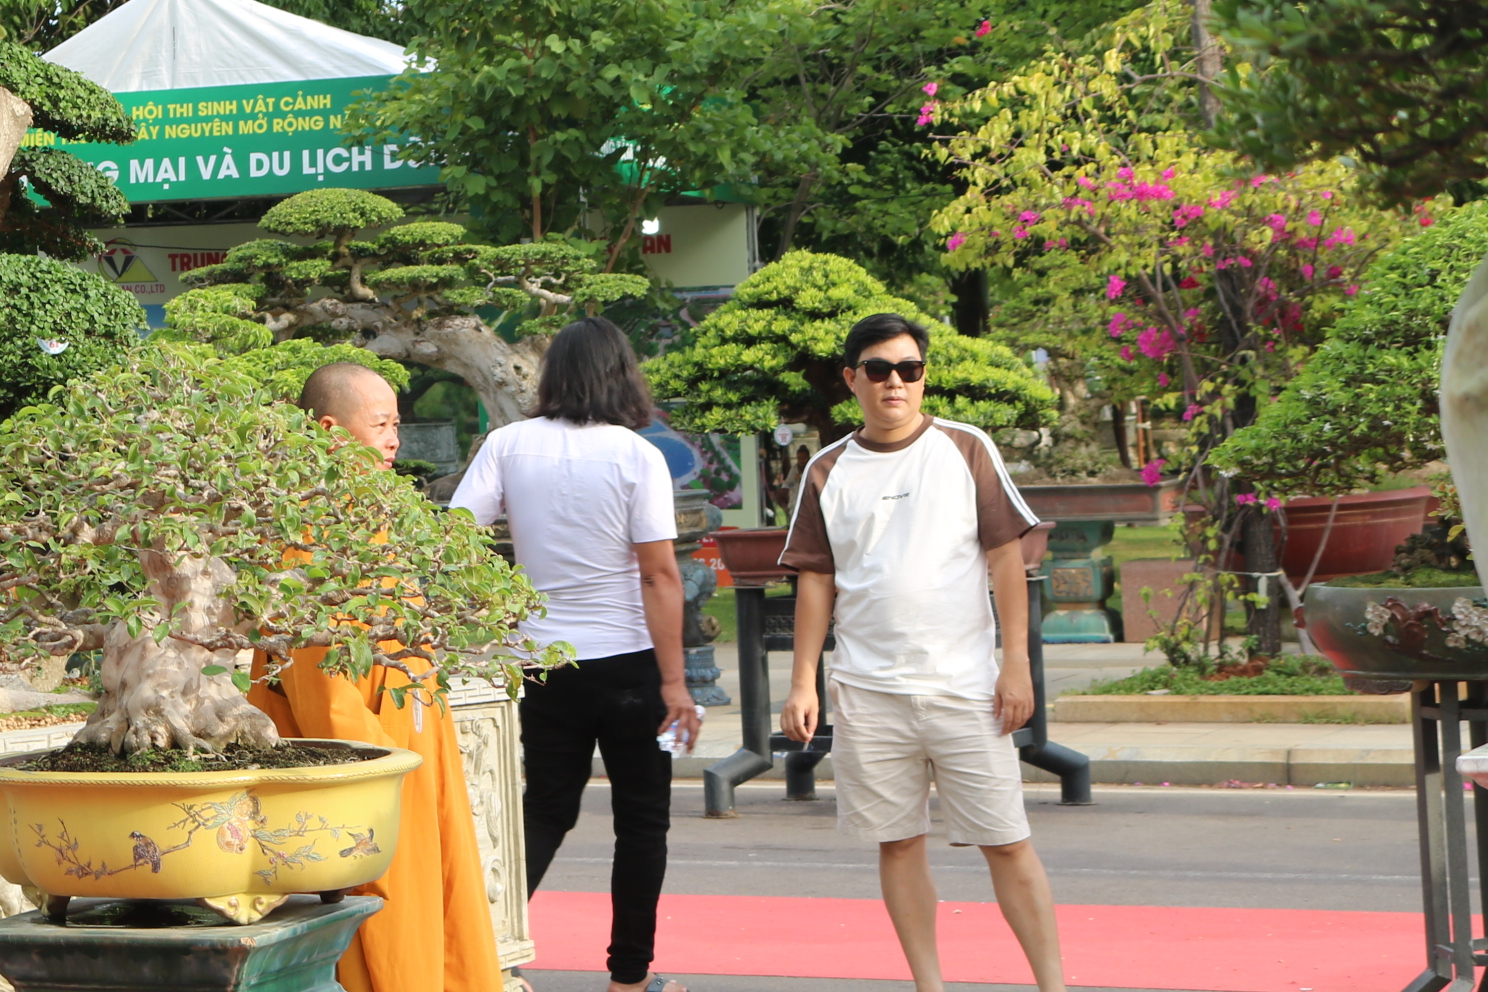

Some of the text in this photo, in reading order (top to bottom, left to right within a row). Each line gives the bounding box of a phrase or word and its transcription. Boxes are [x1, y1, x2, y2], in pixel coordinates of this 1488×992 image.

[132, 101, 163, 123] HỘI
[167, 103, 193, 118] THI
[198, 100, 237, 117] SINH
[280, 90, 331, 112] CẢNH
[137, 122, 160, 141] ÂY
[165, 118, 233, 139] NGUYÊN
[239, 113, 268, 135] MỞ
[273, 113, 325, 136] RỘNG
[129, 156, 186, 190] MẠI
[195, 146, 240, 180] VÀ
[249, 150, 291, 178] DU
[302, 145, 372, 182] LỊCH
